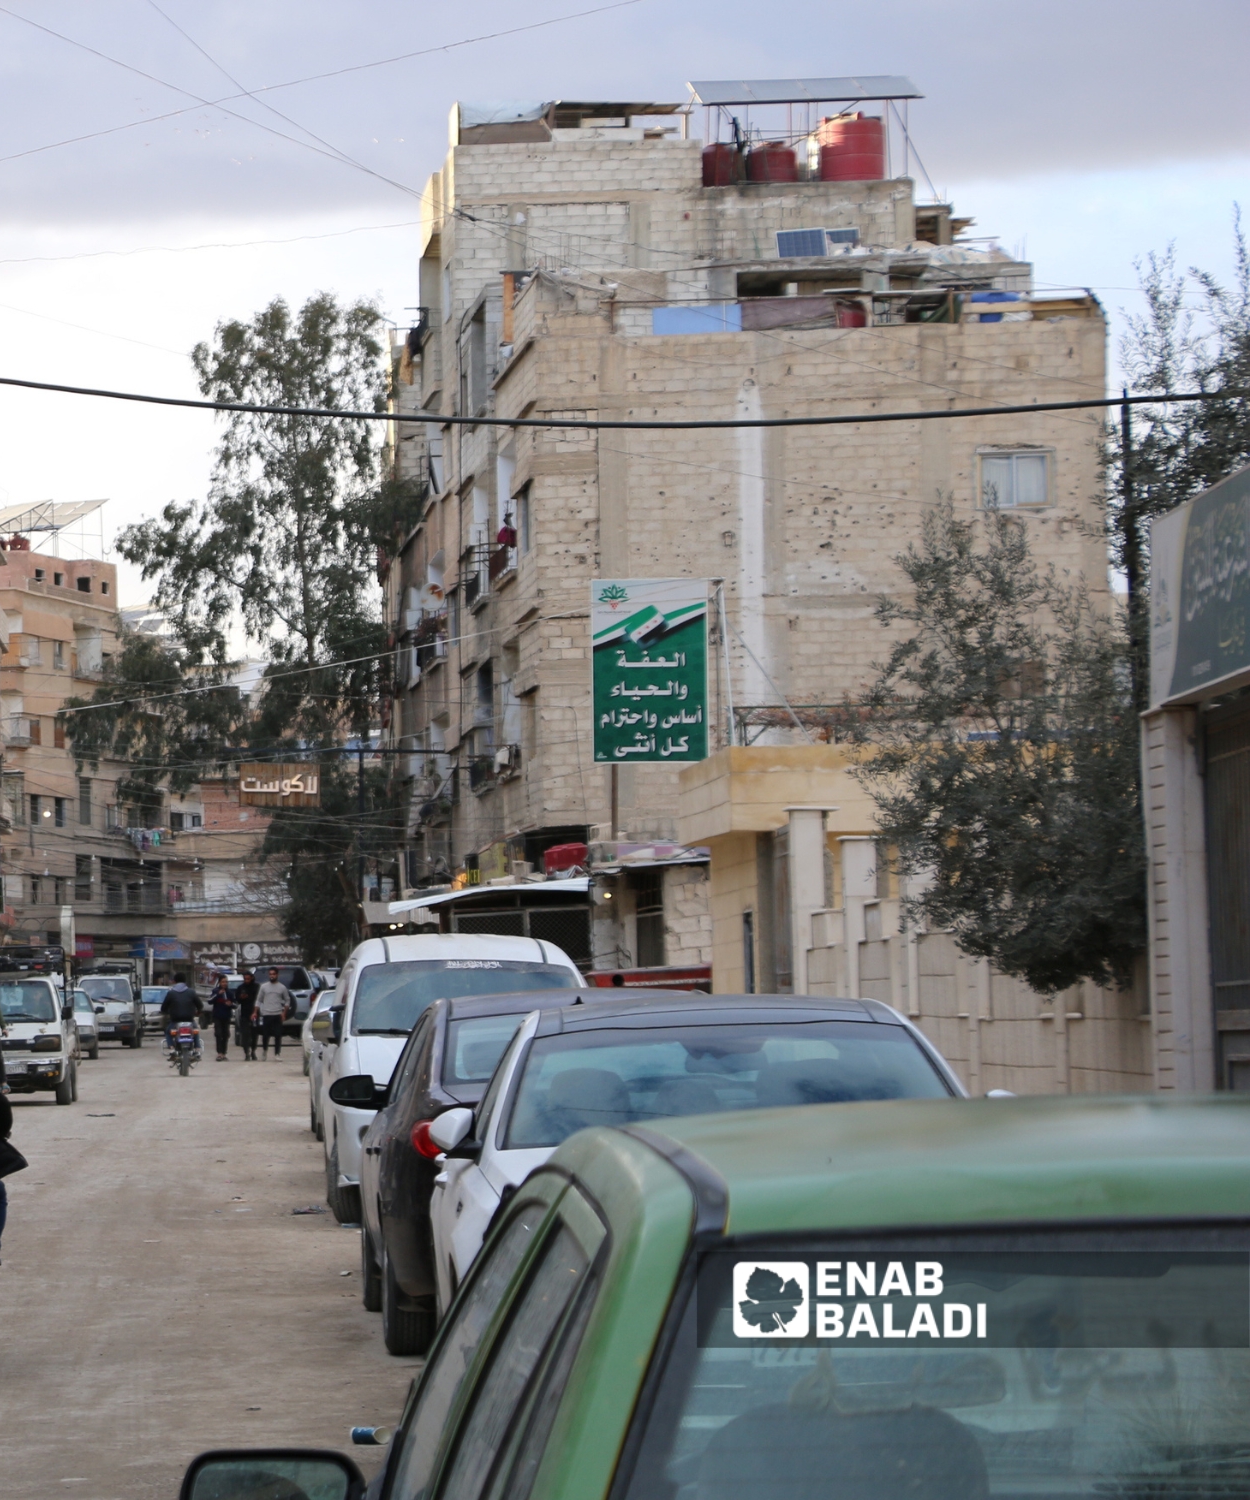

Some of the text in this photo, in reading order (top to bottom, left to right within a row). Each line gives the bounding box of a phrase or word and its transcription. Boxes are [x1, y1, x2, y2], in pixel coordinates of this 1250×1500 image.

[616, 649, 686, 668] العفة
[610, 680, 688, 700] والحياء
[600, 706, 702, 729] أساس واحترام
[614, 732, 689, 757] كل أنثى
[241, 774, 318, 796] لاكوست
